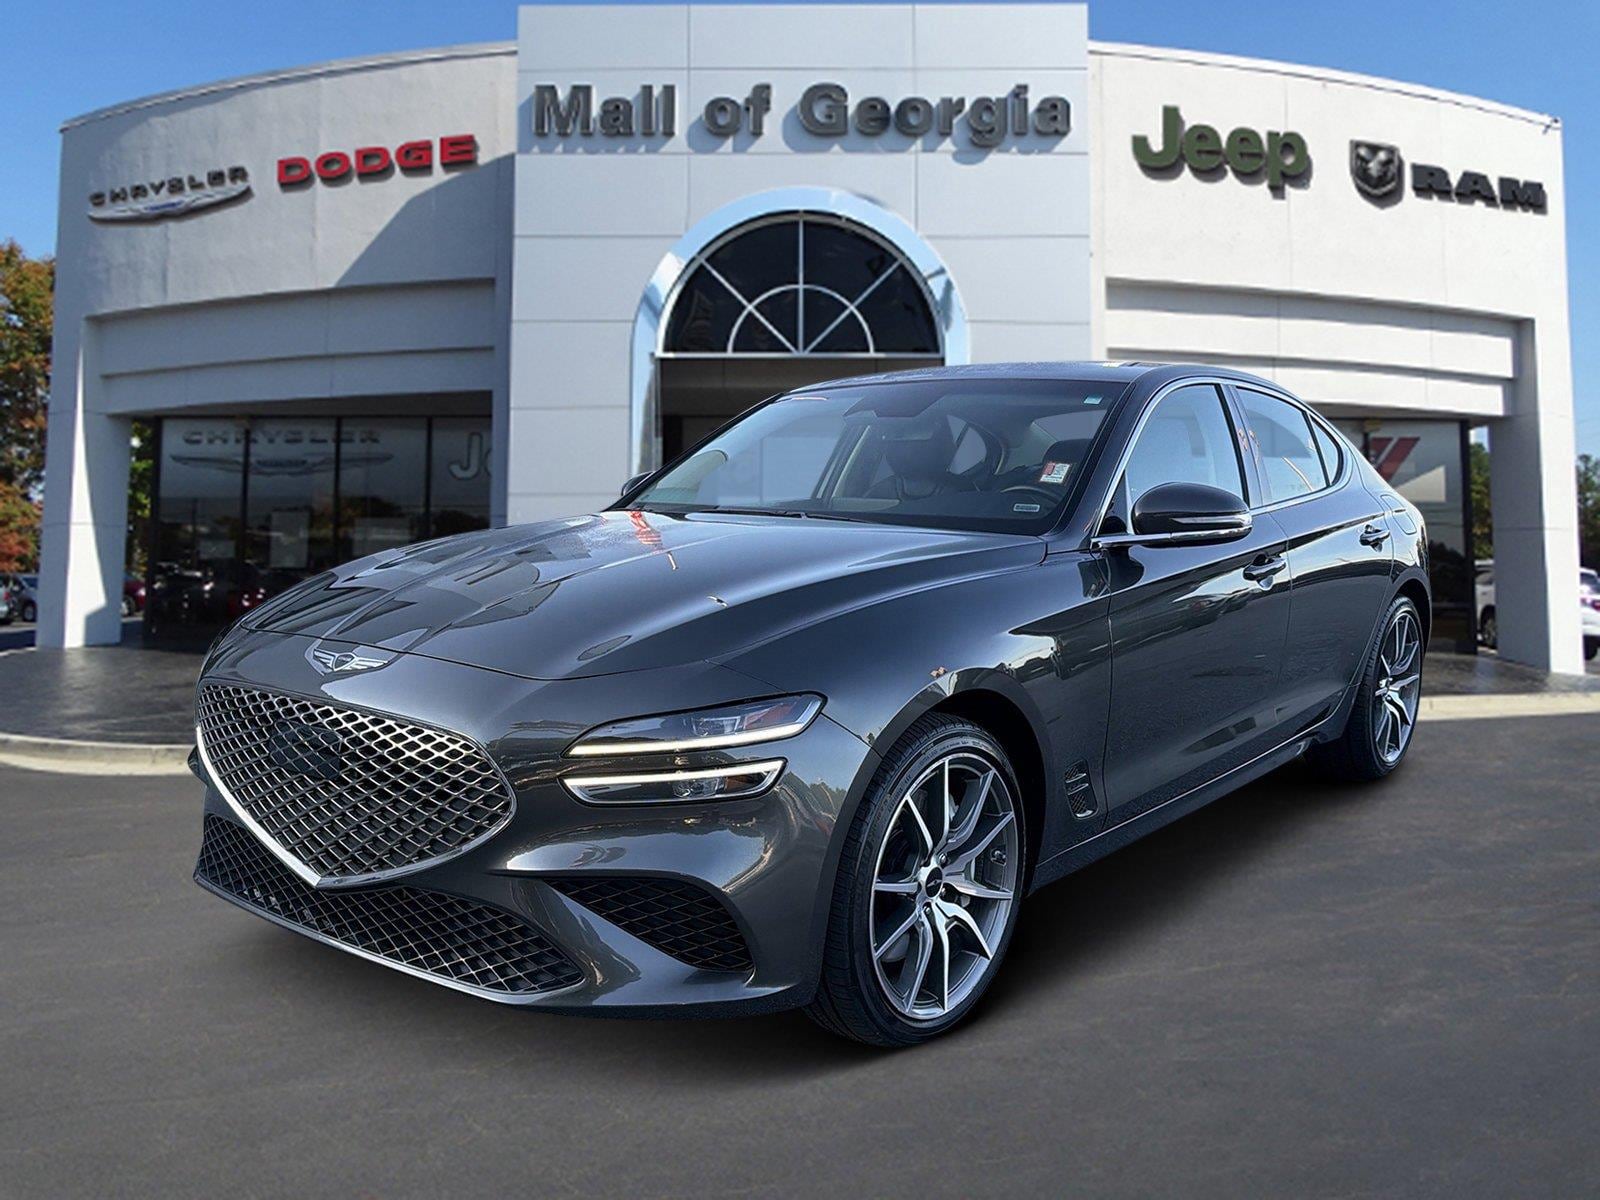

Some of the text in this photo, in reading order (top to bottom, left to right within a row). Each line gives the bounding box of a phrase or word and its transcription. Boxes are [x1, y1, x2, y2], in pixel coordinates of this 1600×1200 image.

[533, 83, 1071, 147] Mall of Georgia
[277, 134, 477, 184] DODGE
[1132, 105, 1309, 188] Jeep
[90, 166, 248, 207] CHRYSLER
[1411, 163, 1546, 209] RAM
